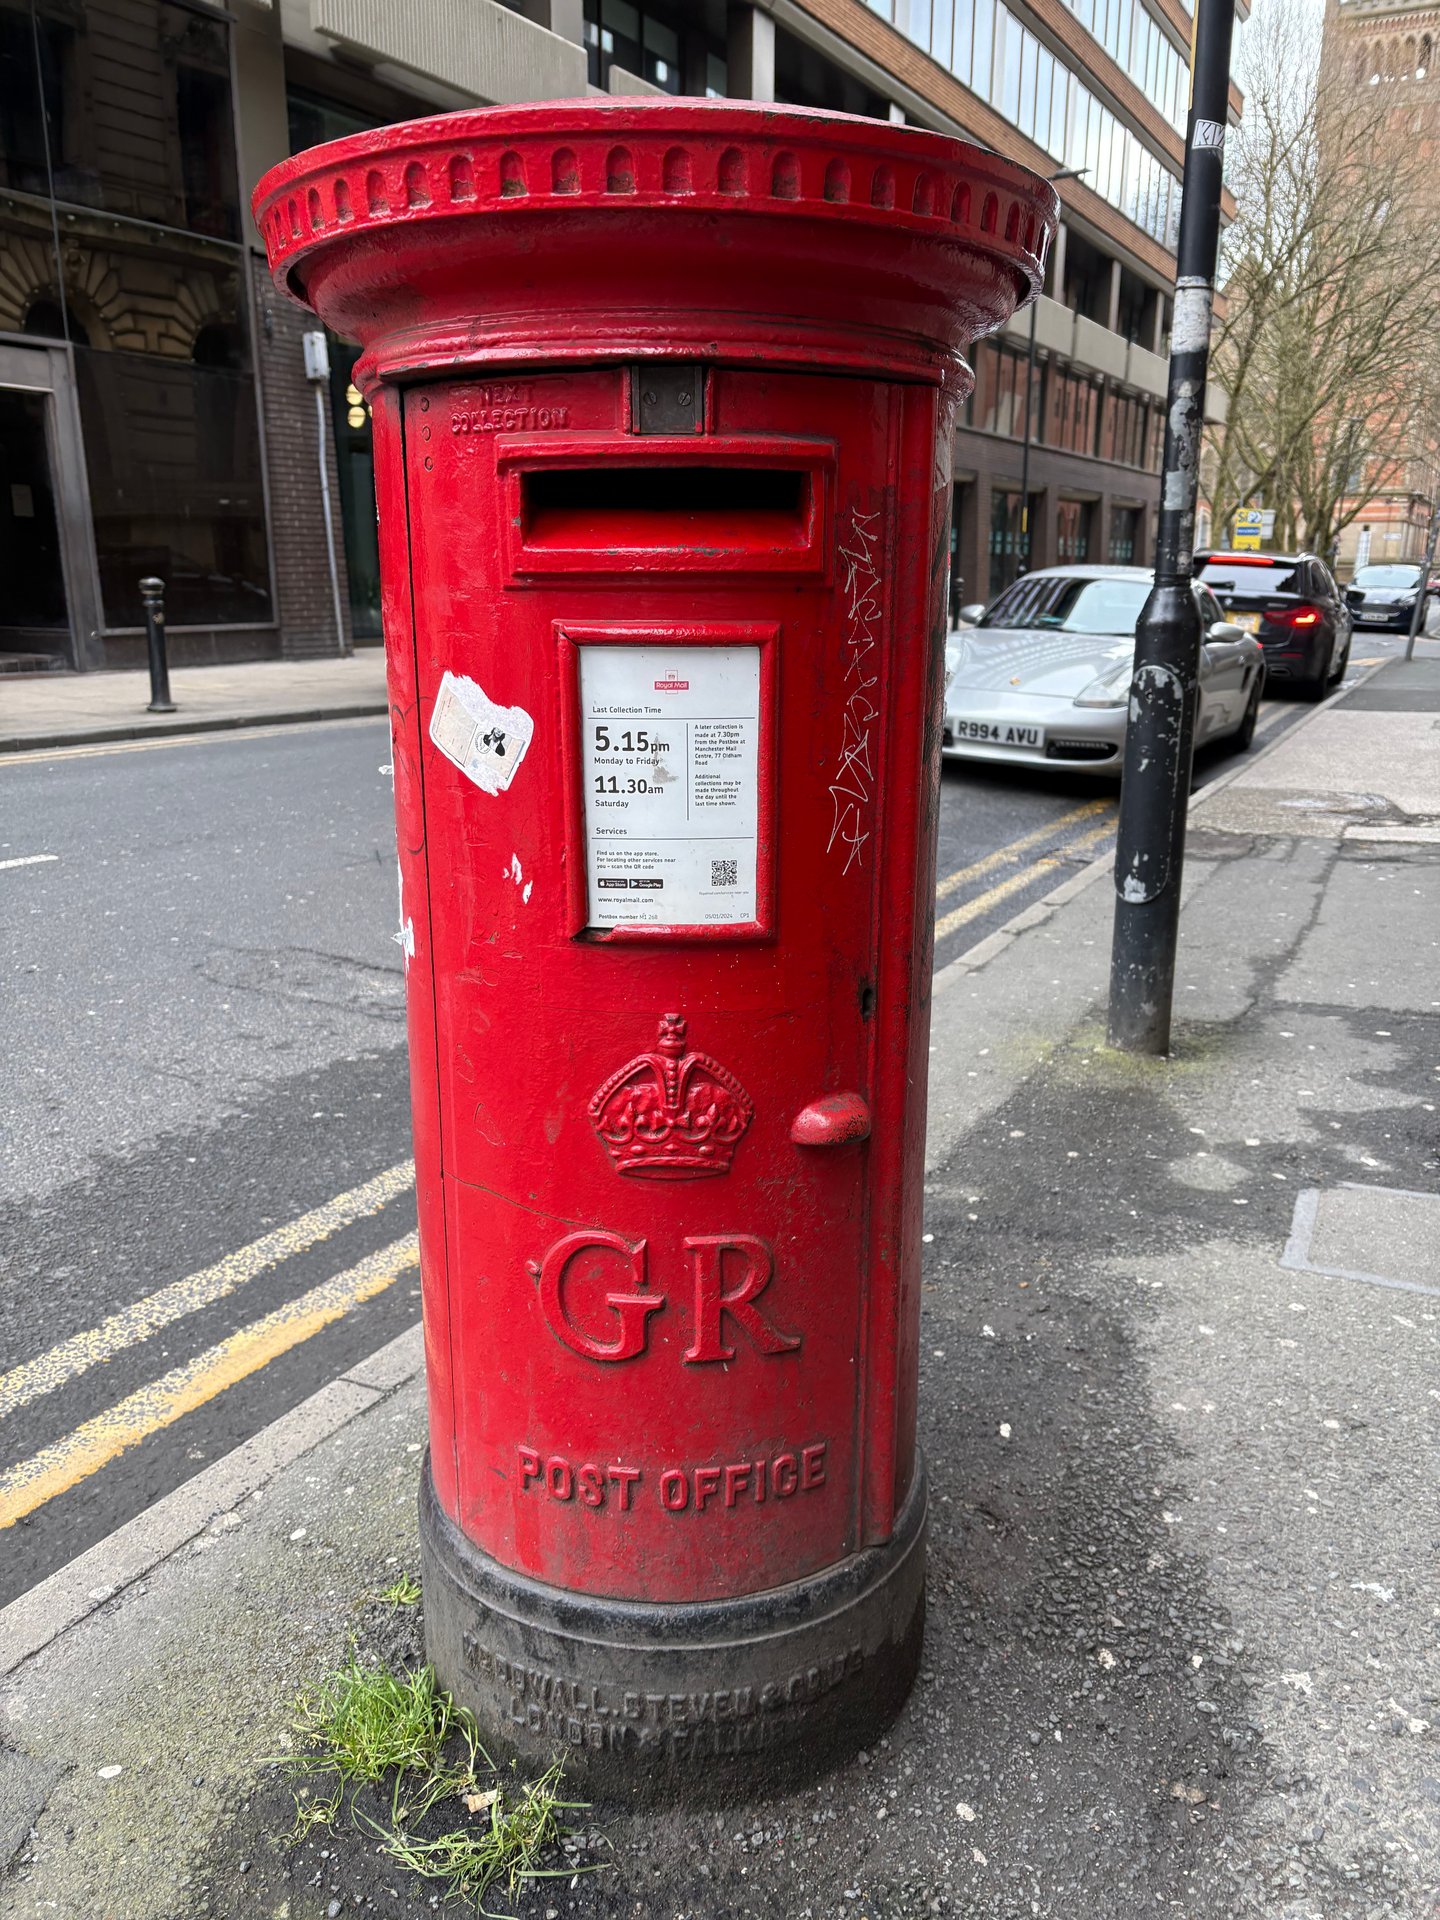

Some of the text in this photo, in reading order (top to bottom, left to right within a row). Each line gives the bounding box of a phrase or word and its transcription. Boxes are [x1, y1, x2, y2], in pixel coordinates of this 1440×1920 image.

[481, 382, 536, 407] NEXT
[451, 407, 571, 435] COLLECTION
[595, 726, 670, 754] 5.15pm
[958, 720, 1038, 746] R994 AVU
[594, 757, 623, 766] Monday
[636, 757, 660, 766] Friday
[594, 775, 664, 794] 11.30am
[595, 800, 629, 808] Saturday
[540, 1230, 802, 1363] GR
[518, 1442, 827, 1512] POST OFFICE
[623, 1686, 754, 1722] STEVEN
[509, 1694, 630, 1752] LONDON
